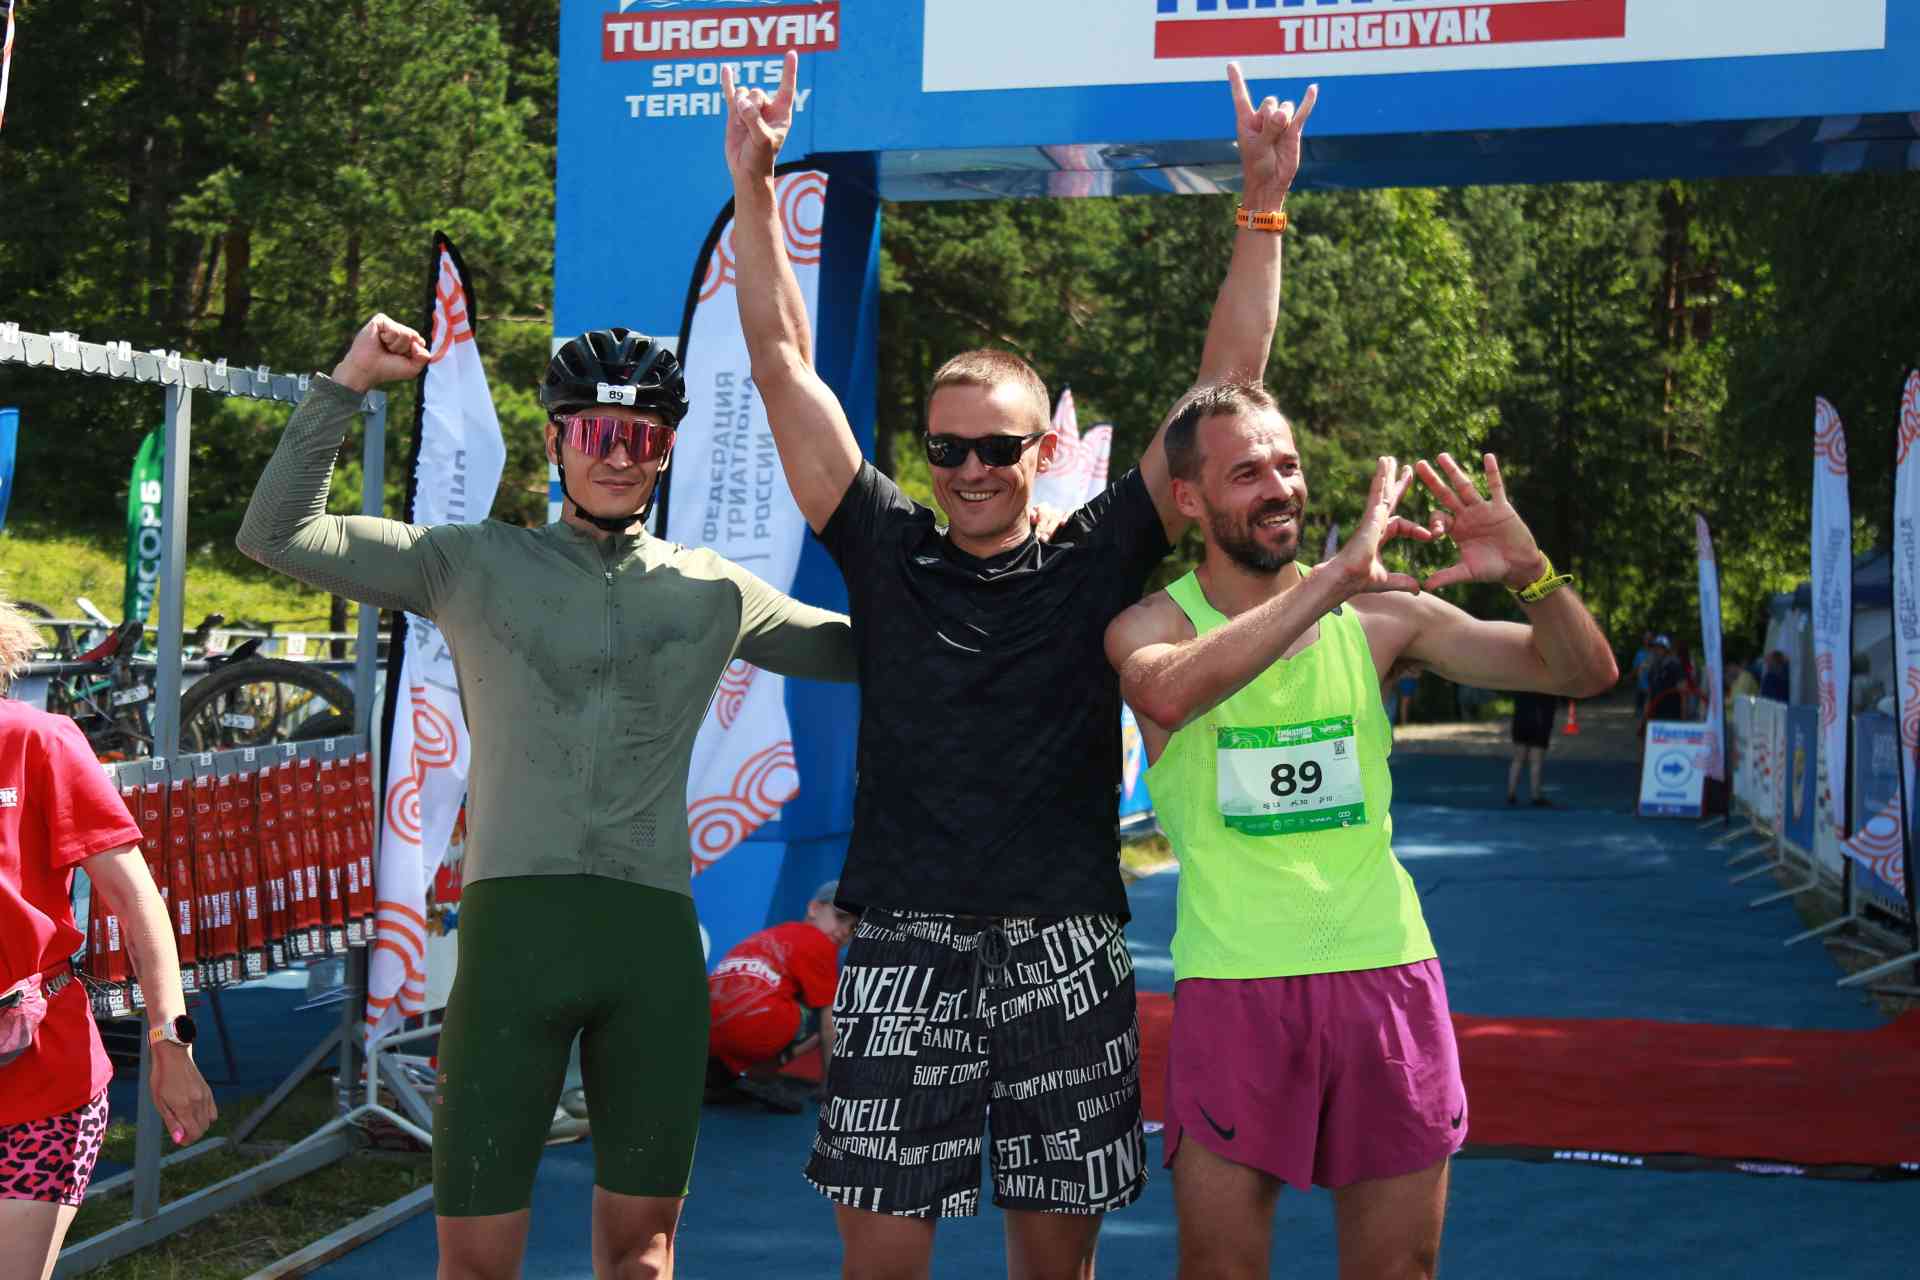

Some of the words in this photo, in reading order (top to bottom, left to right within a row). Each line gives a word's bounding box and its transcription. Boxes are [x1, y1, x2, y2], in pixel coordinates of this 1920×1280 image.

[606, 11, 835, 53] TURGOYAK
[1279, 8, 1491, 52] TURGOYAK
[609, 390, 624, 400] 89
[701, 371, 735, 543] ФЕДЕРАЦИЯ
[753, 432, 775, 540] РОССИИ
[1270, 761, 1322, 796] 89
[832, 965, 934, 1014] O'NEILL
[1001, 983, 1060, 1023] COMPANY
[1057, 958, 1109, 1022] EST.
[1017, 960, 1053, 985] CRUZ
[864, 1016, 926, 1057] 1952
[921, 1025, 972, 1054] SANTA
[912, 1065, 949, 1086] SURF
[1009, 1070, 1063, 1100] COMPANY
[1065, 1061, 1107, 1087] QUALITY
[829, 1096, 901, 1132] O'NEILL
[1077, 1089, 1127, 1122] QUALITY
[831, 1135, 897, 1162] CALIFORNIA
[899, 1145, 930, 1166] SURF
[995, 1135, 1038, 1170] EST.
[1040, 1128, 1083, 1162] 1952
[998, 1173, 1045, 1199] SANTA
[1051, 1178, 1086, 1205] CRUZ
